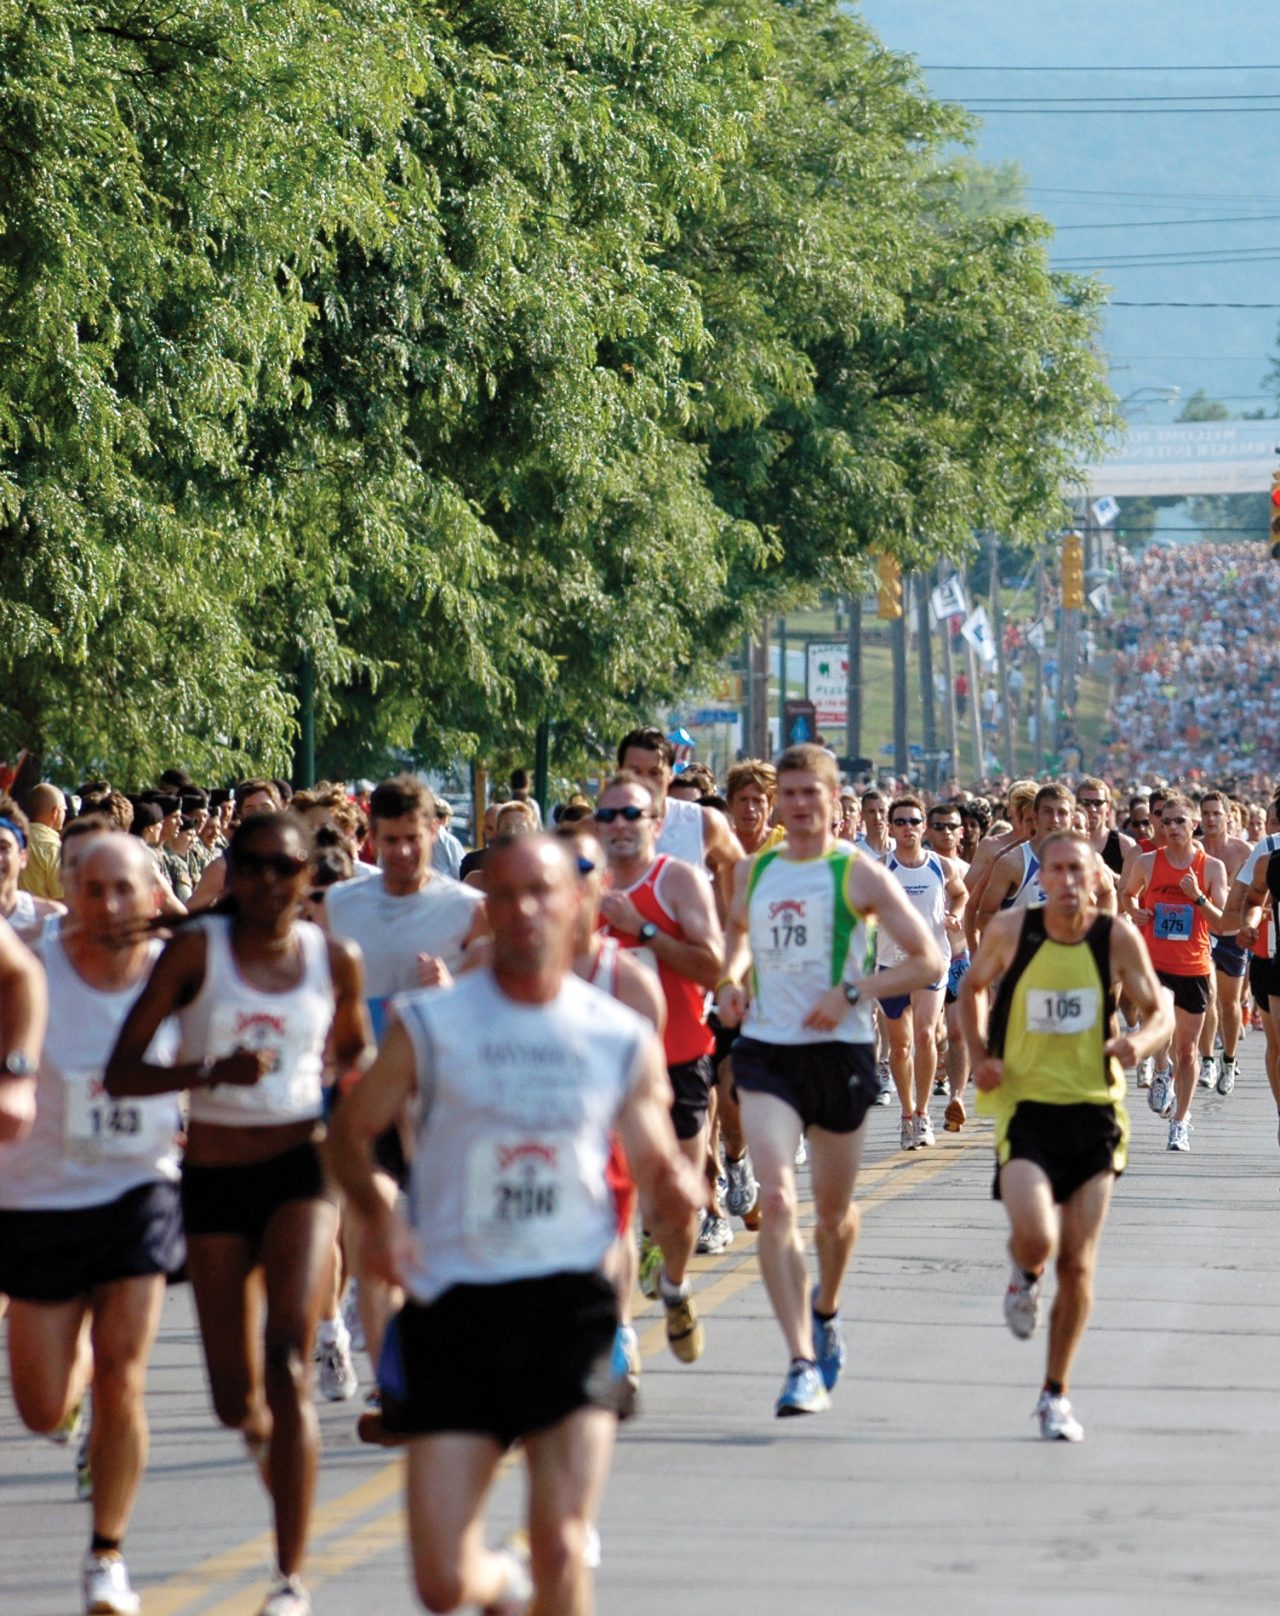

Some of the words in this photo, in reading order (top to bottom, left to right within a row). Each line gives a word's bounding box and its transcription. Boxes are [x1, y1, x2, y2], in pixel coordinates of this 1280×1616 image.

[1160, 918, 1184, 932] 475
[771, 925, 807, 948] 178
[1045, 997, 1081, 1019] 105
[90, 1106, 142, 1134] 143
